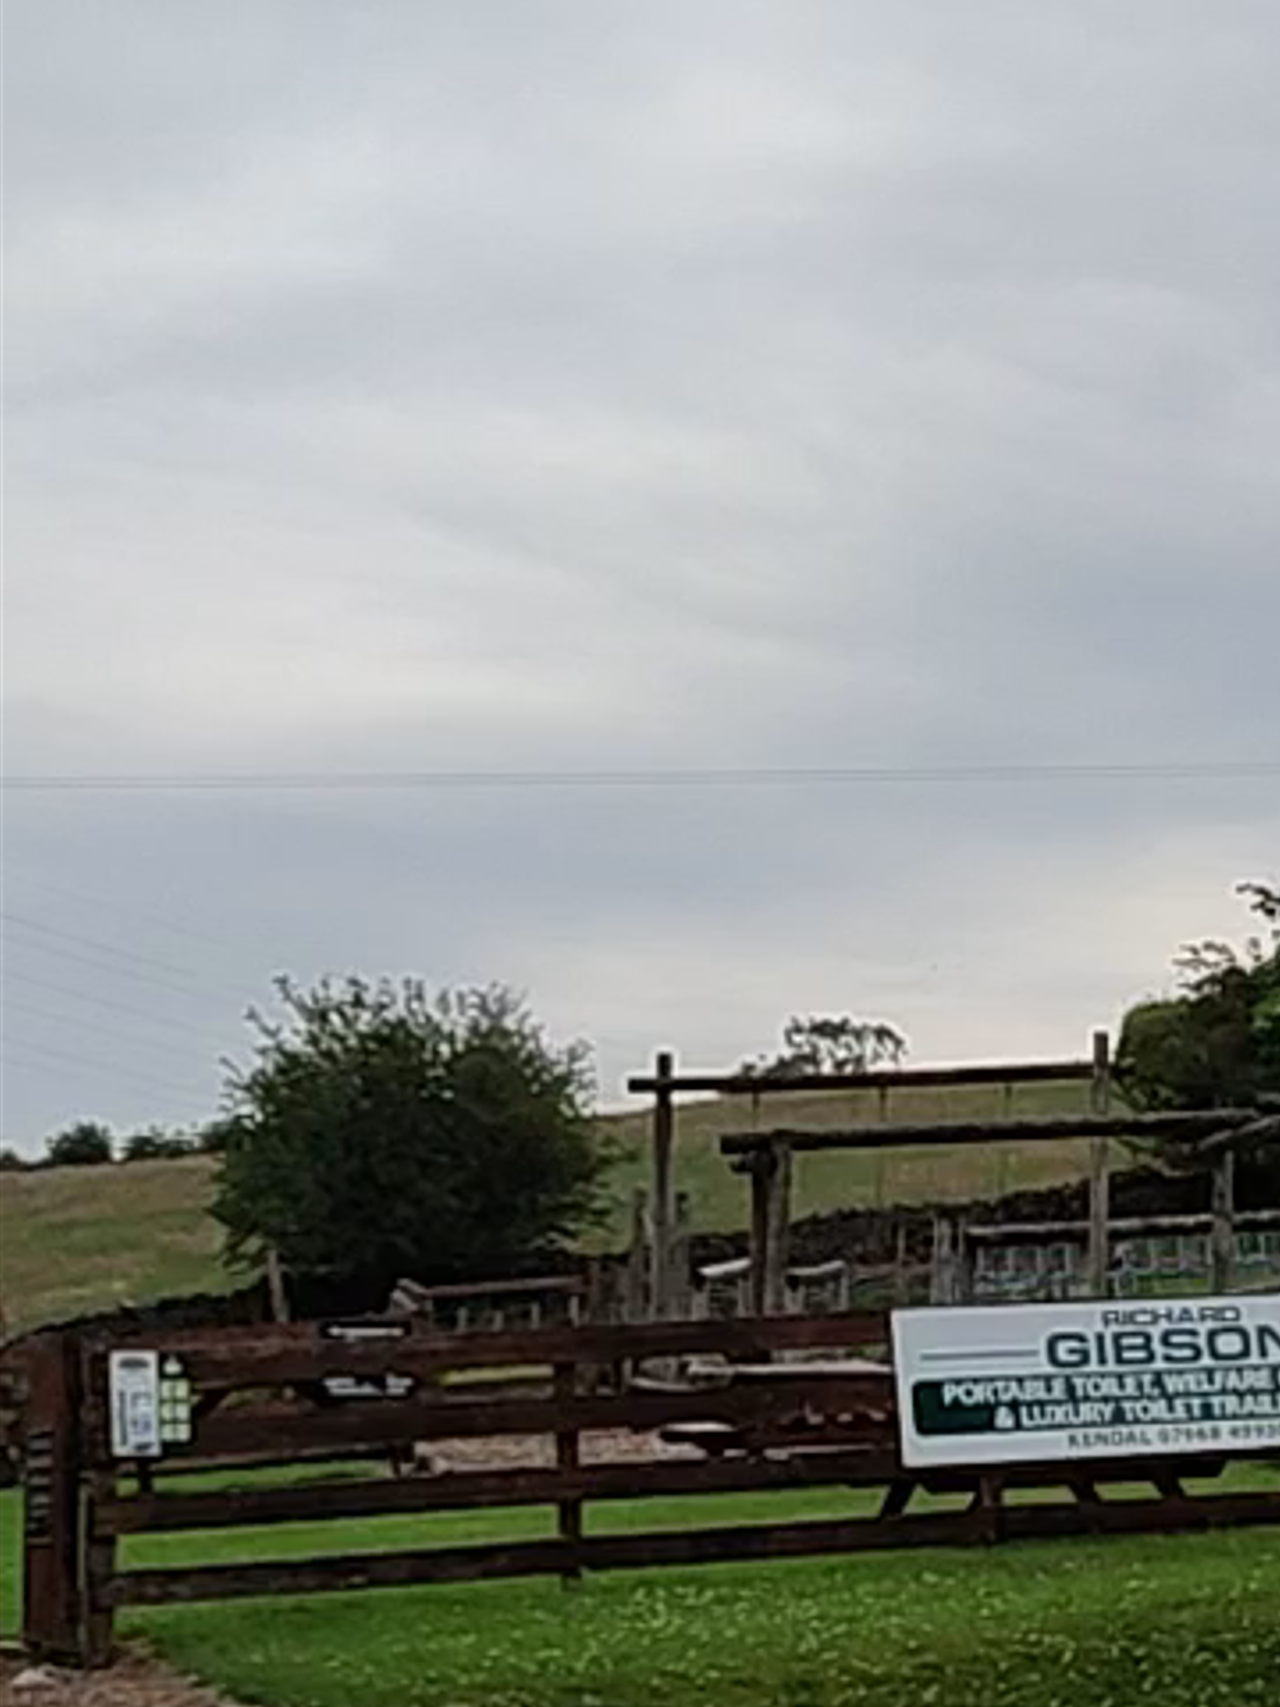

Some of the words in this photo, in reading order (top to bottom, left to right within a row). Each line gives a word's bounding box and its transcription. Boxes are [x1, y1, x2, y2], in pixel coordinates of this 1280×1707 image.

[1102, 1306, 1241, 1327] RICHARD
[943, 1377, 1068, 1407] PORTABLE
[1162, 1369, 1275, 1394] WELFARE
[1019, 1401, 1116, 1427] LUXURY
[1121, 1396, 1201, 1421] TOILET
[1068, 1429, 1151, 1448] KENDAL
